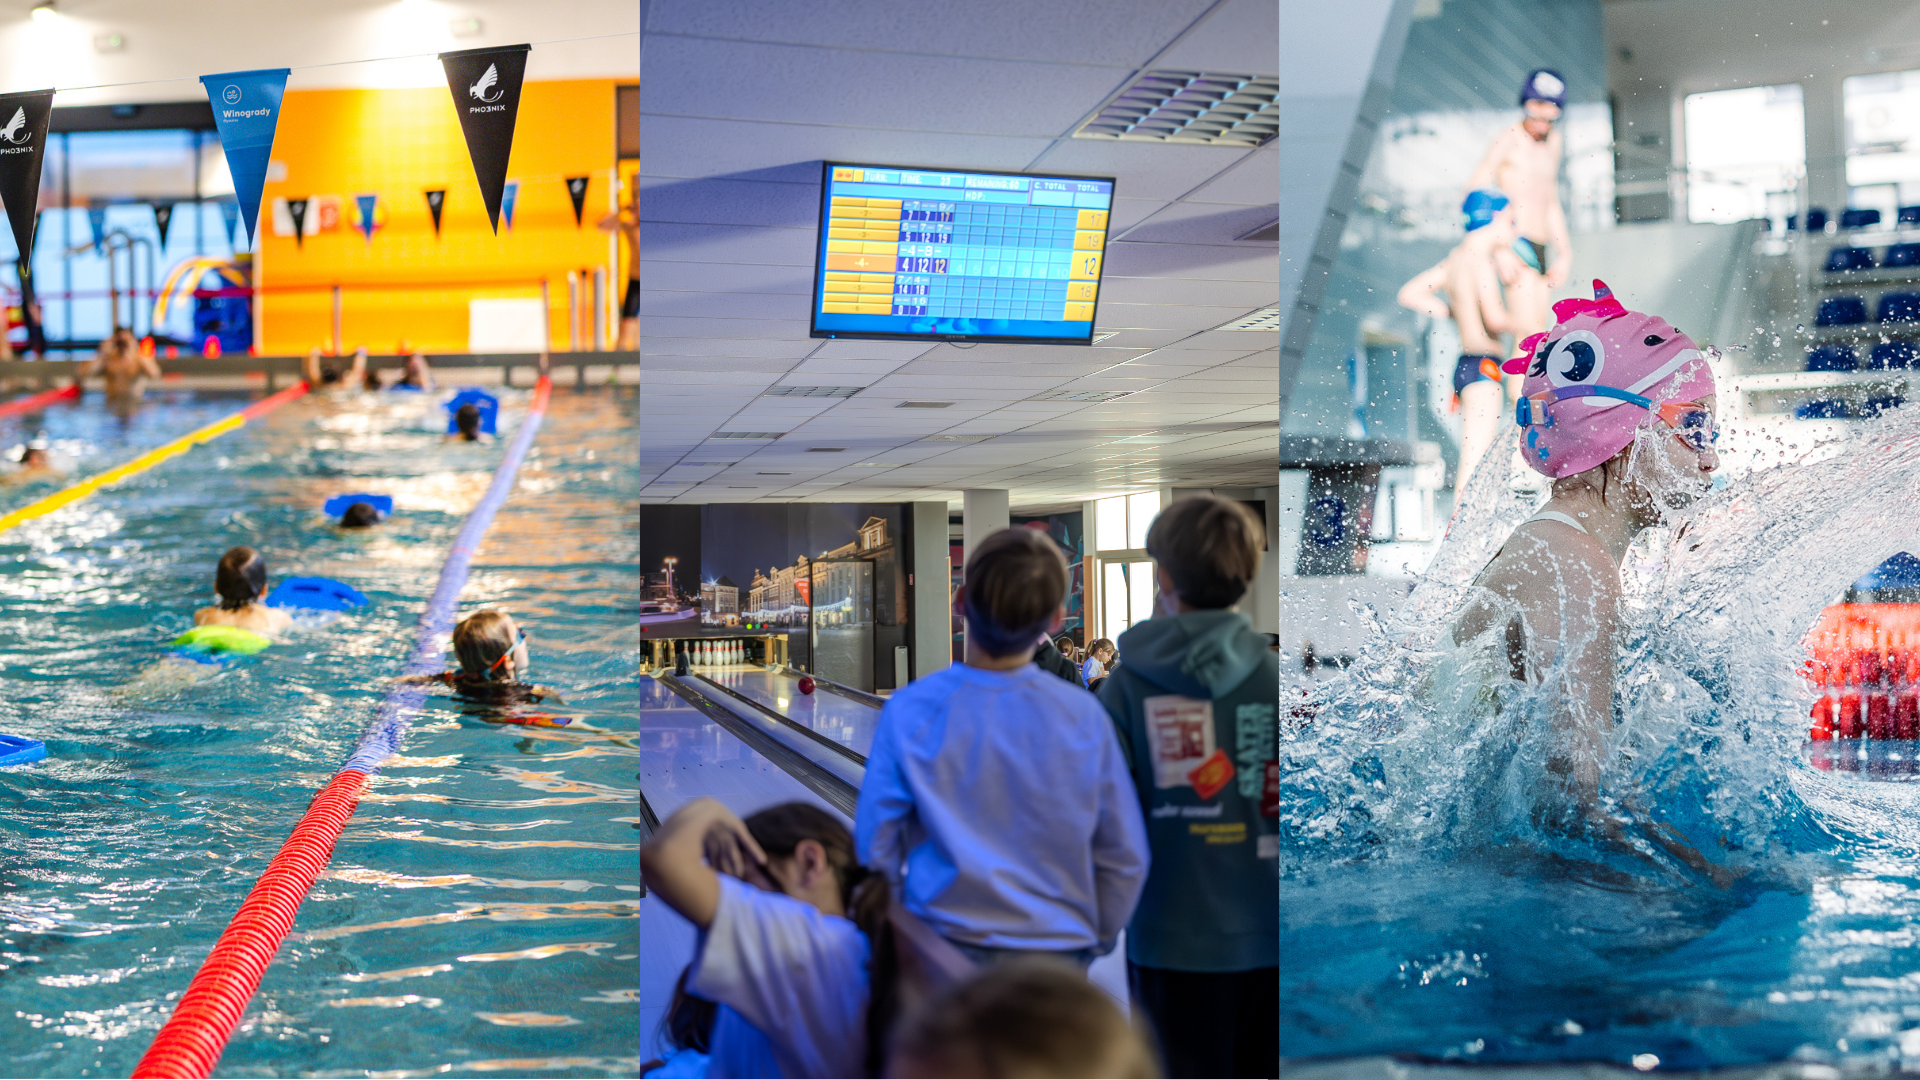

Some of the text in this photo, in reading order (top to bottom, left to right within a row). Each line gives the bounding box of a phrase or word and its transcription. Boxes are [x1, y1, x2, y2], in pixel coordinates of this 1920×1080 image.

[222, 107, 271, 119] Winogrady
[469, 104, 506, 114] PHO3NIX
[0, 146, 34, 155] PHO3NIX
[902, 174, 923, 185] TIME:
[1044, 182, 1067, 191] TOTAL
[1077, 184, 1099, 192] TOTAL
[1091, 214, 1102, 227] 17
[1088, 235, 1099, 248] 19
[902, 258, 909, 272] 4
[918, 258, 929, 273] 12
[935, 259, 946, 274] 12
[1084, 257, 1097, 275] 12
[1080, 286, 1092, 298] 18
